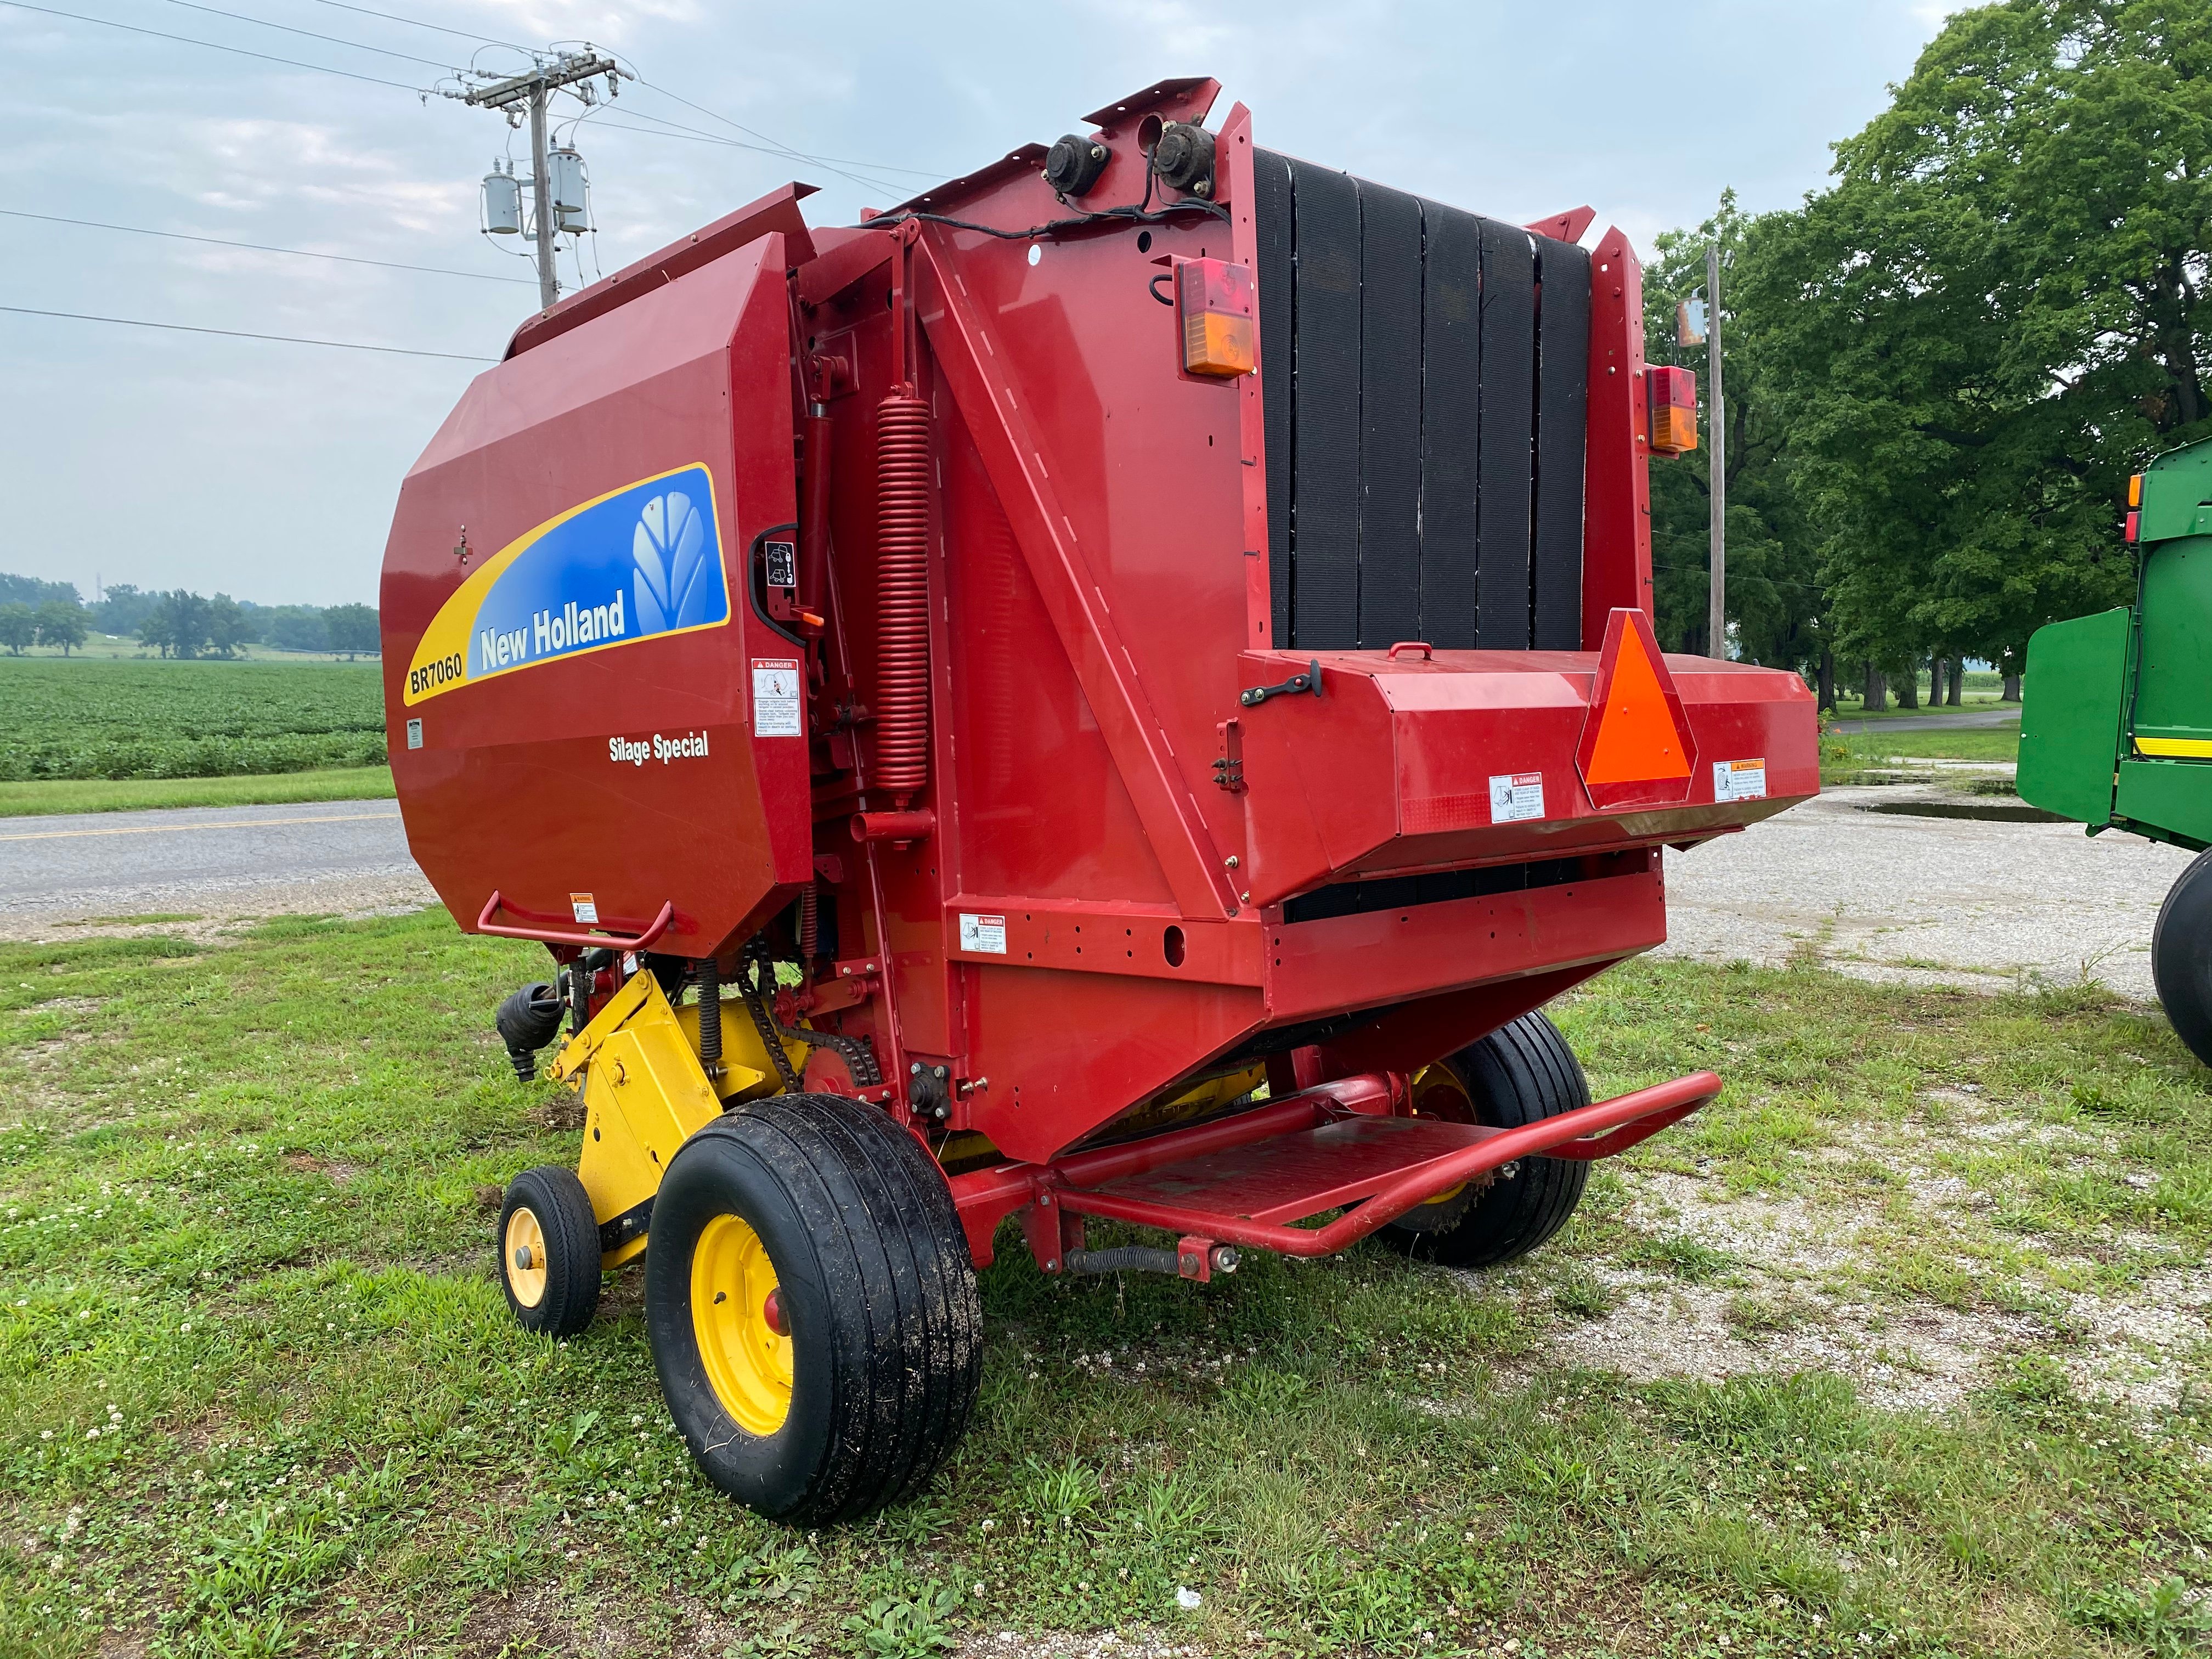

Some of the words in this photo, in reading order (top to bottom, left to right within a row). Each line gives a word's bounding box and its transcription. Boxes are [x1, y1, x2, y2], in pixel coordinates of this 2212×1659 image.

[480, 627, 528, 670] New
[533, 589, 625, 654] Holland
[410, 653, 462, 695] BR7060
[609, 737, 651, 766] Silage
[653, 730, 708, 765] Special
[1519, 776, 1540, 784] DANGER
